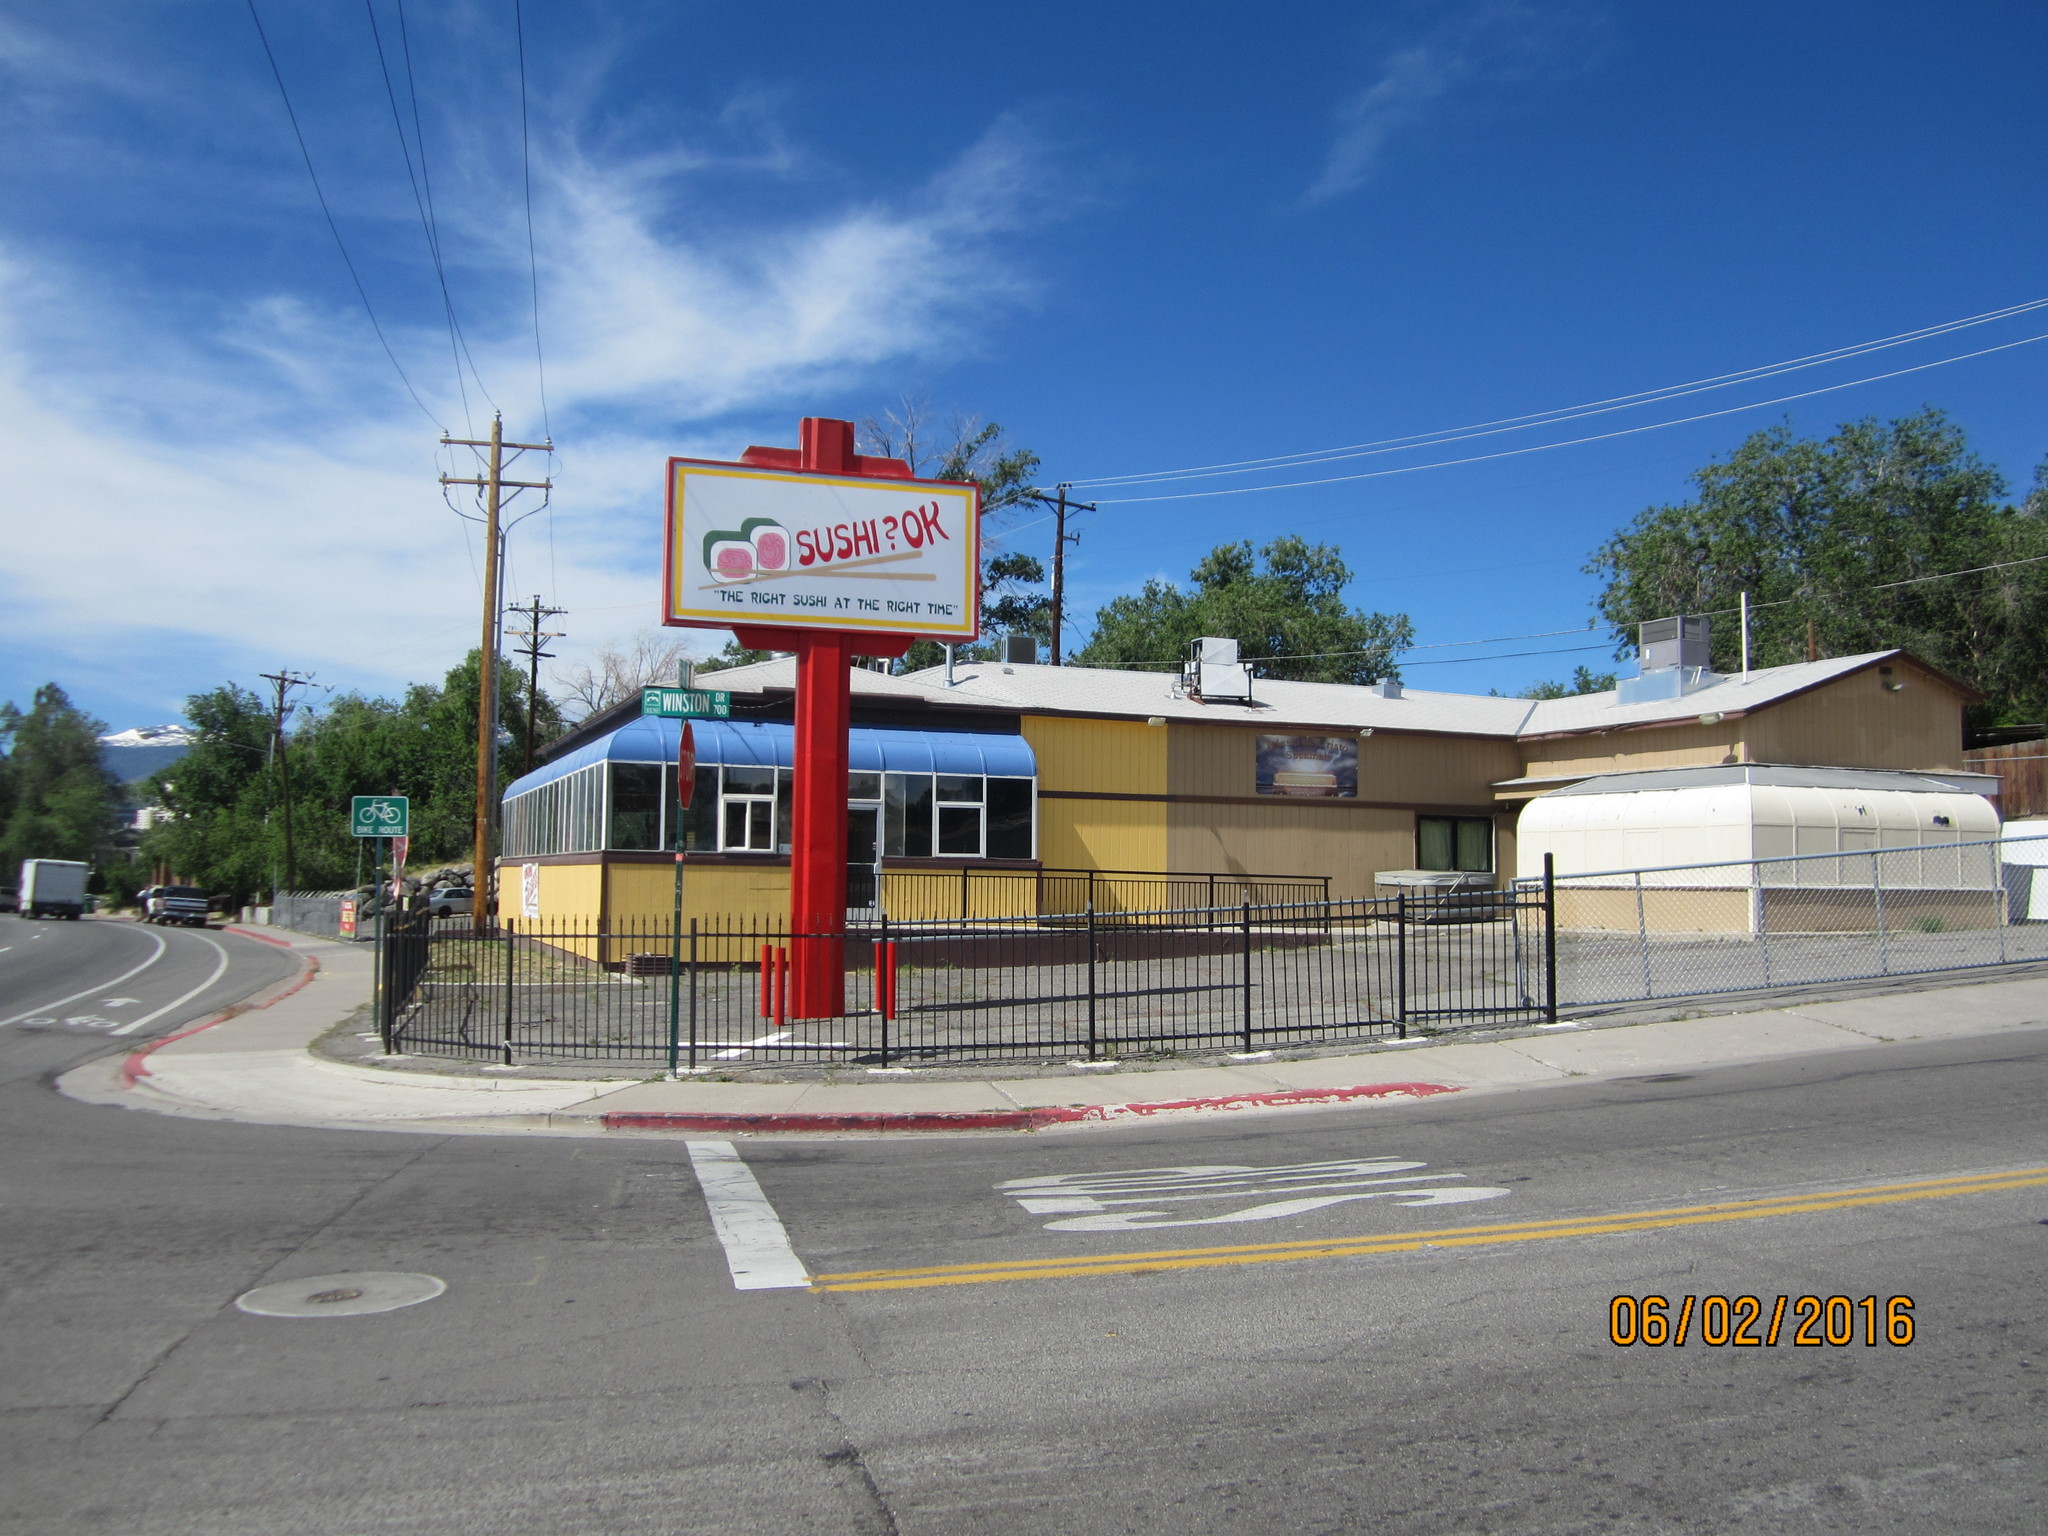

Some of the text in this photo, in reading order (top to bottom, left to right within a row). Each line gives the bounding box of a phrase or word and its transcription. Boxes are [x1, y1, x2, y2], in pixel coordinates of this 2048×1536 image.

[751, 592, 786, 605] RIGHT
[793, 594, 827, 607] SUSHI
[834, 597, 850, 609] AT
[857, 598, 880, 611] THE
[887, 600, 921, 614] RIGHT
[716, 693, 725, 702] DR
[663, 693, 709, 713] WINSTON
[714, 705, 727, 715] 700
[357, 826, 403, 834] BIKE ROUTE
